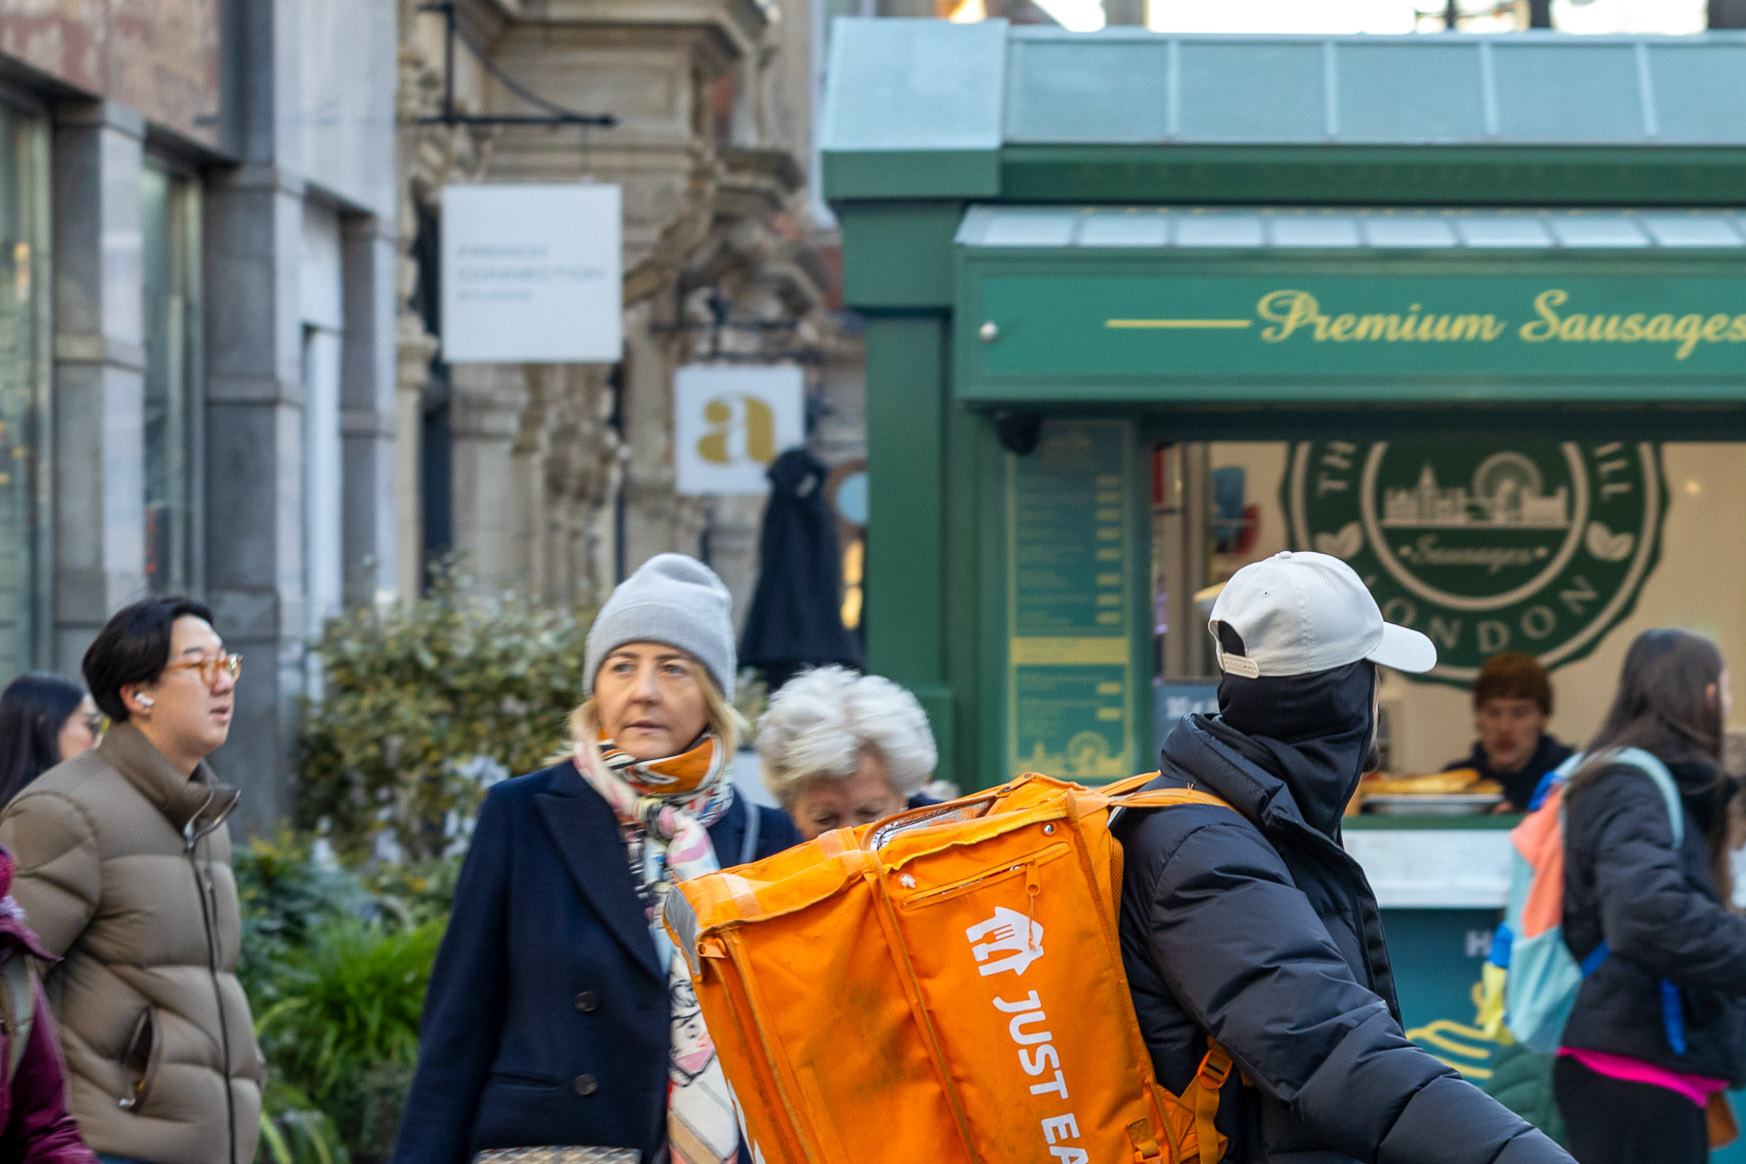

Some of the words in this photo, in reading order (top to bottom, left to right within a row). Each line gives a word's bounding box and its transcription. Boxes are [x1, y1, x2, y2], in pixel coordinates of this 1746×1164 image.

[1256, 289, 1506, 343] Premium
[1365, 574, 1599, 653] ONDON
[992, 989, 1069, 1099] JUST
